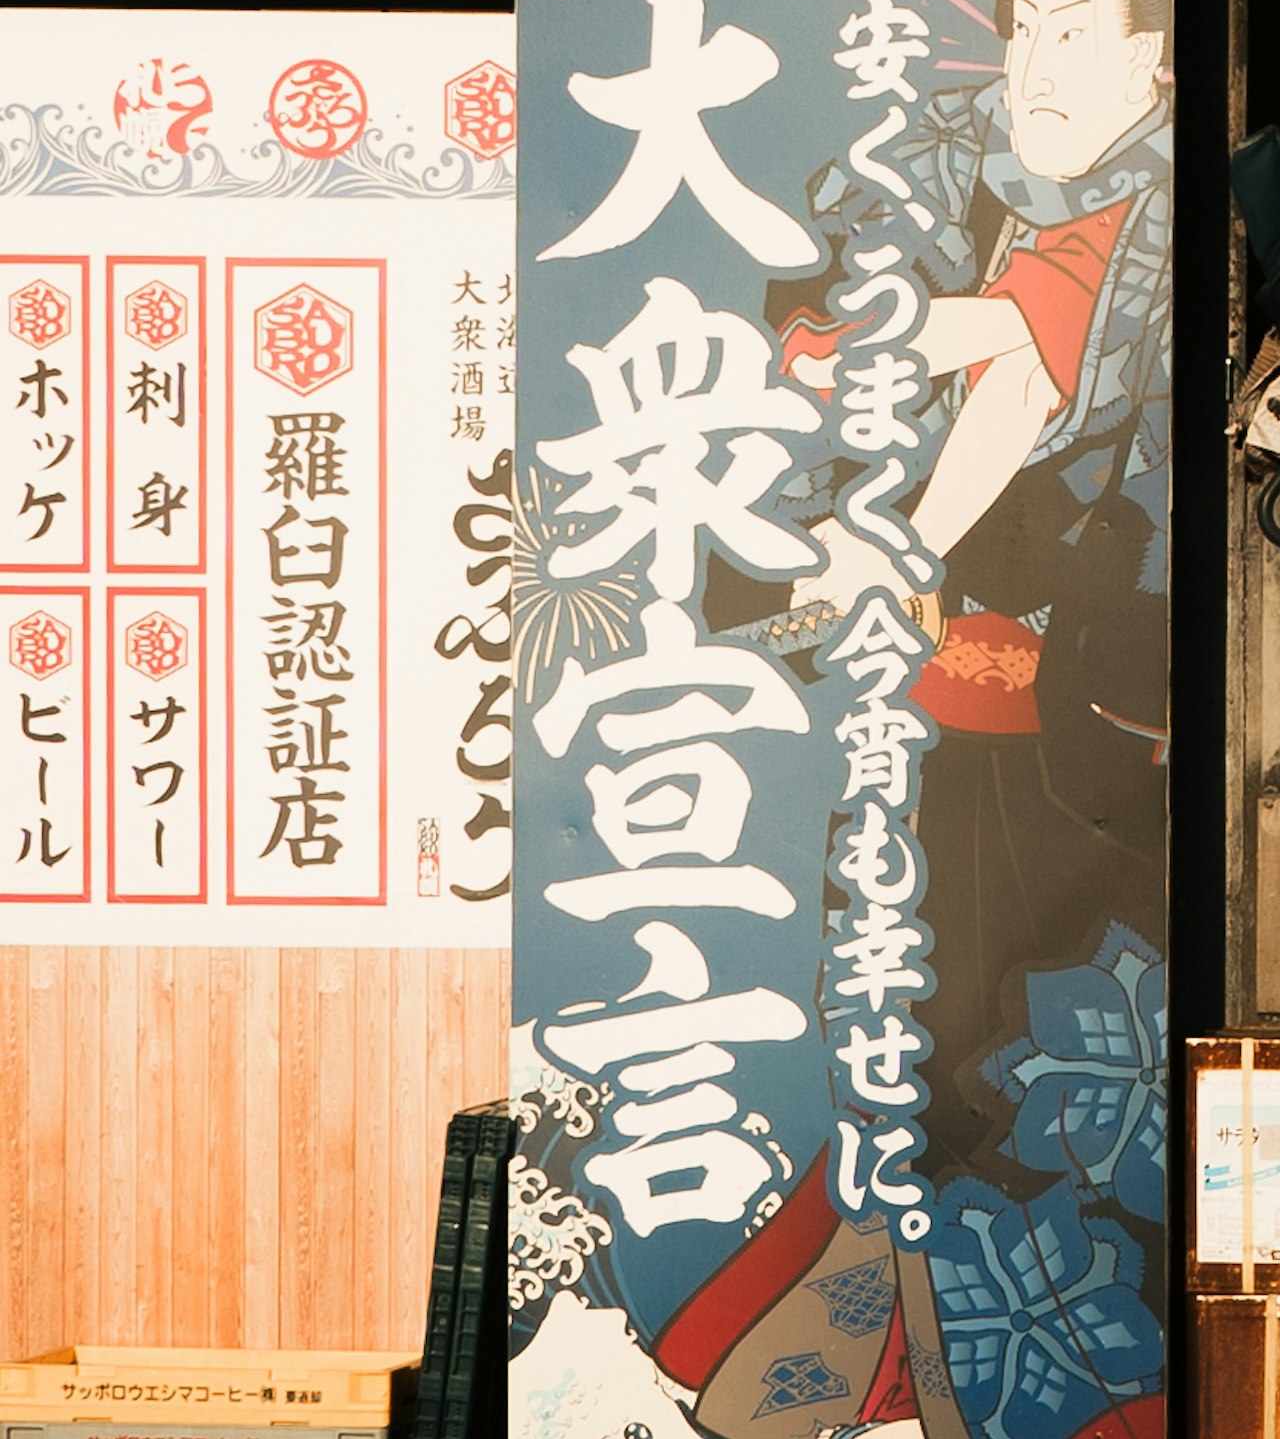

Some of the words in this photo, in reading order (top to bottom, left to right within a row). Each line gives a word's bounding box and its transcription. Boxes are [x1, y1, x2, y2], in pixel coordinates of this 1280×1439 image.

[448, 269, 488, 443] 大衆酒場
[14, 358, 77, 542] ホッケ
[125, 360, 190, 538] 刺身
[257, 410, 356, 870] 羅臼認証店
[15, 693, 73, 869] ビール
[129, 696, 187, 869] サワー
